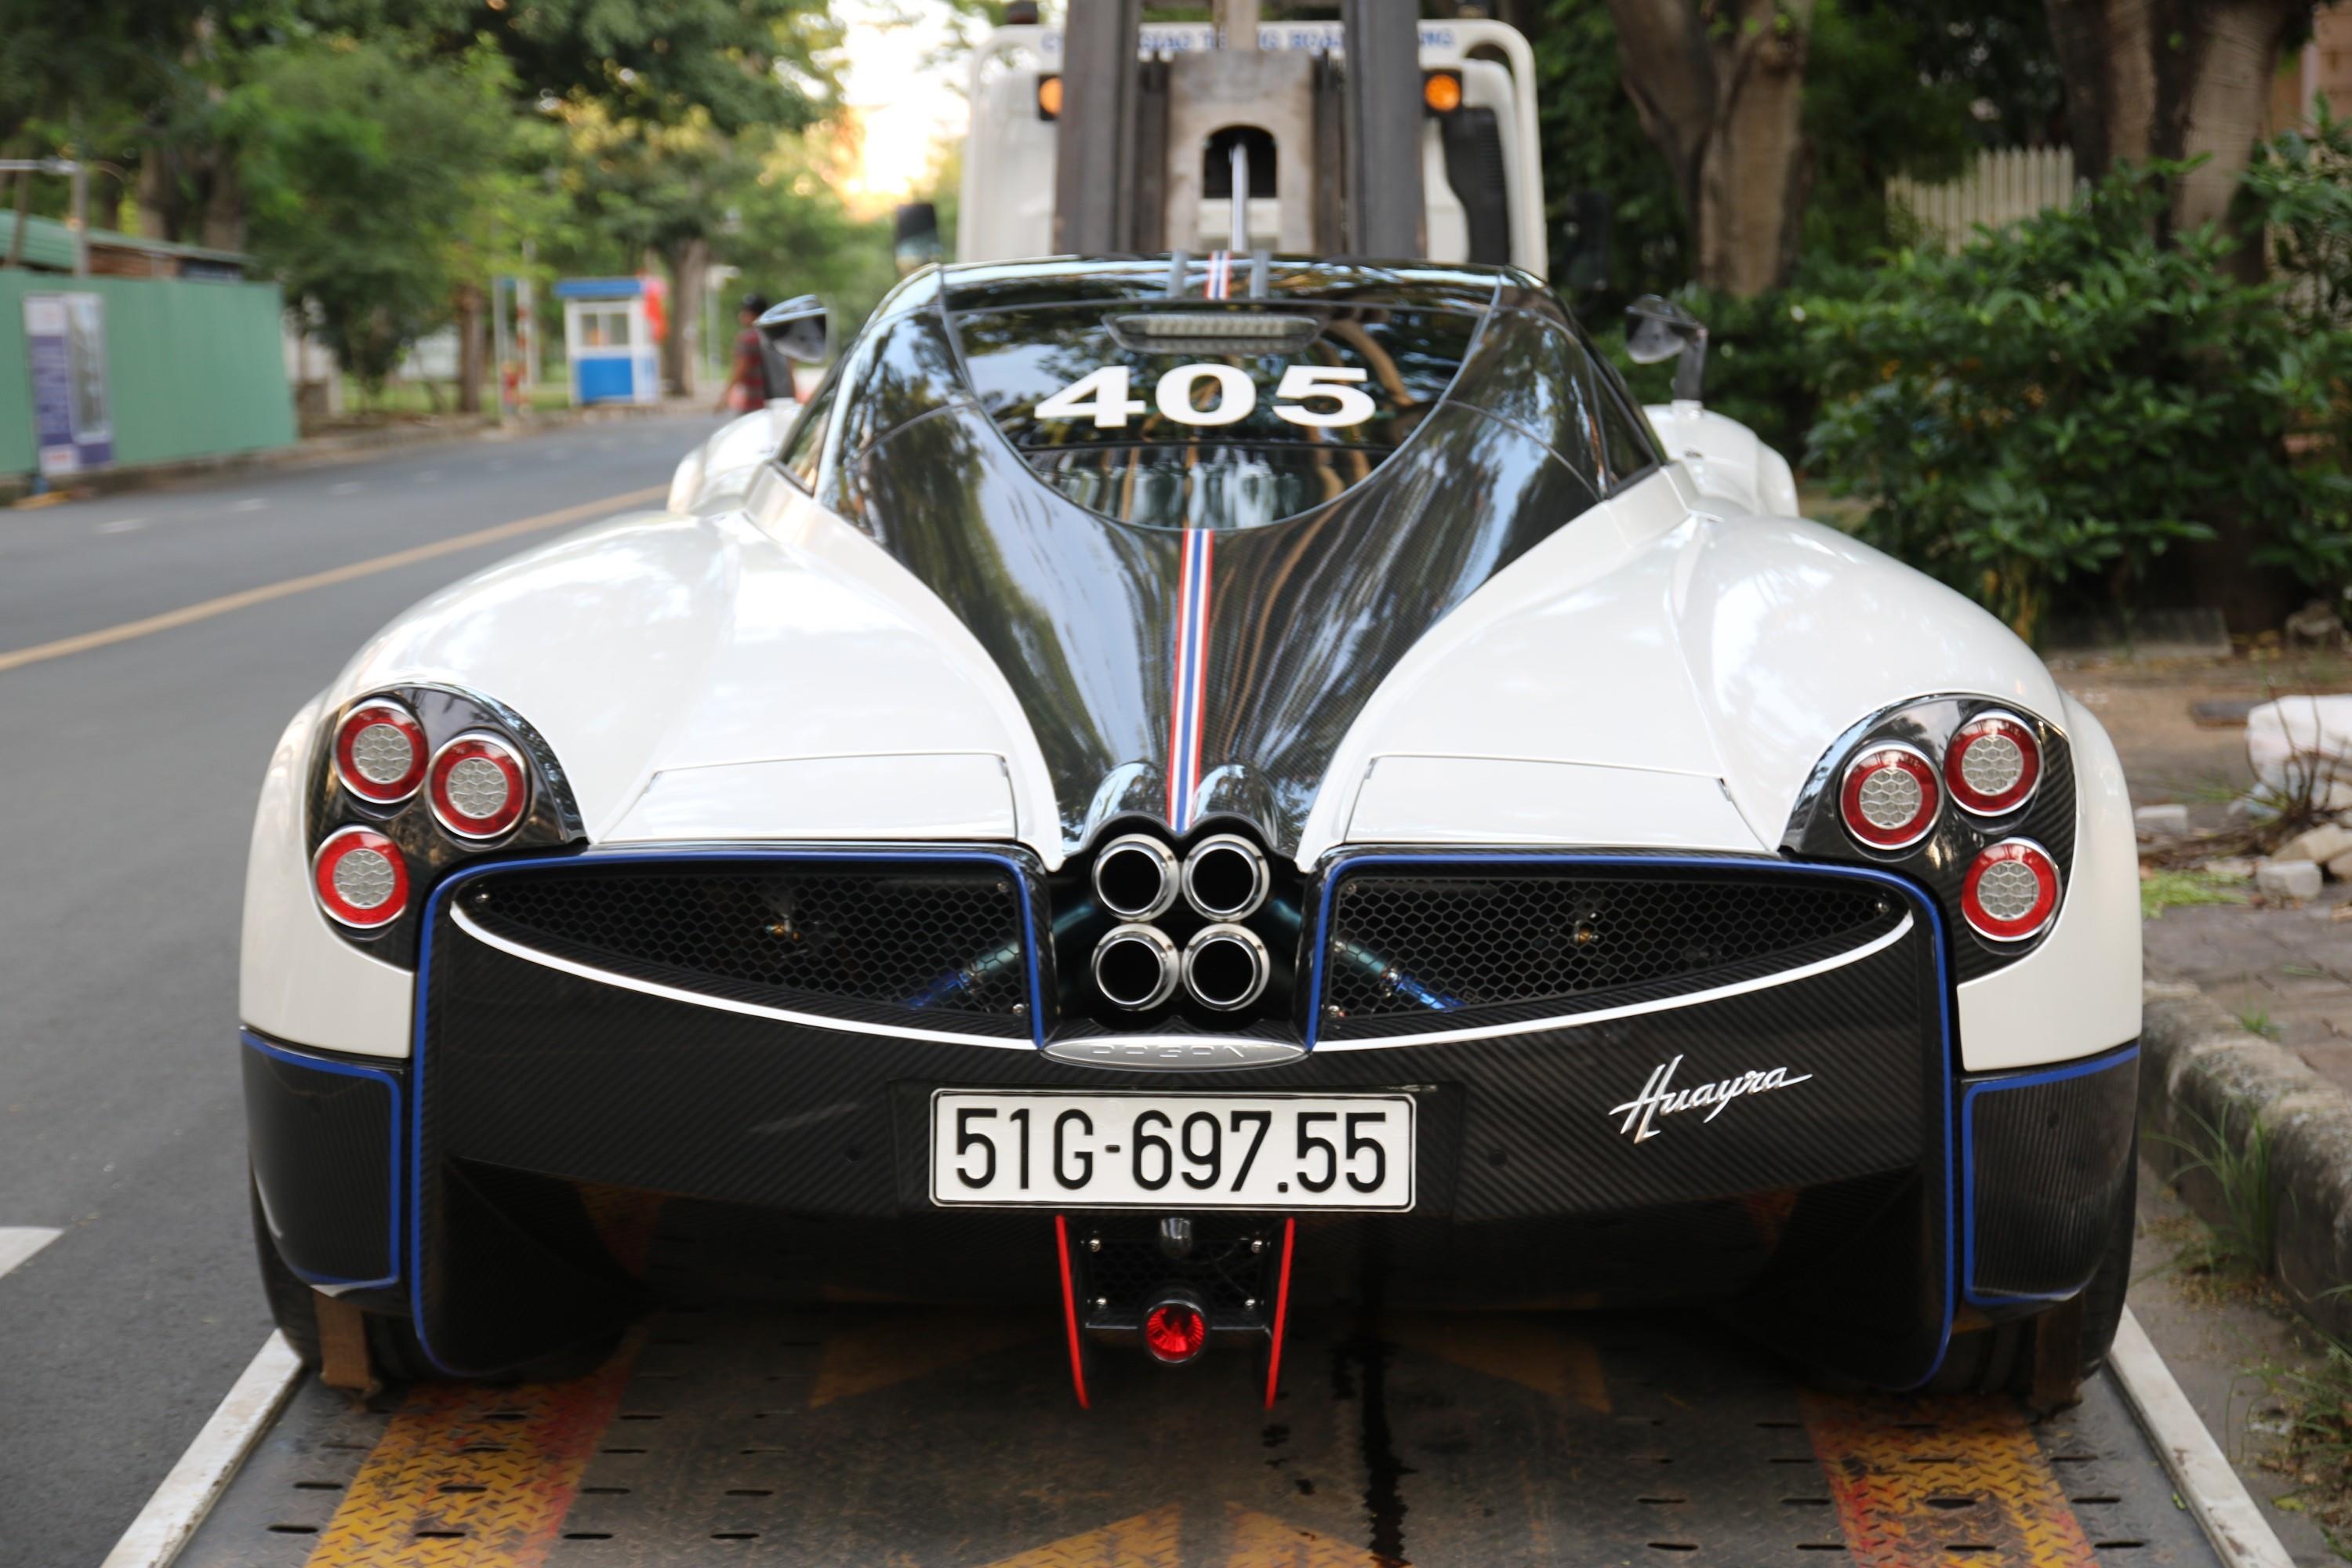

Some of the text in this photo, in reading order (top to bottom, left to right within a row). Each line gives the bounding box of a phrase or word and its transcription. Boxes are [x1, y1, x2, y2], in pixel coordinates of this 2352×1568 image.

[1034, 363, 1376, 428] 405
[1608, 1054, 1813, 1144] Huayra
[956, 1108, 1387, 1194] 51G-697.55
